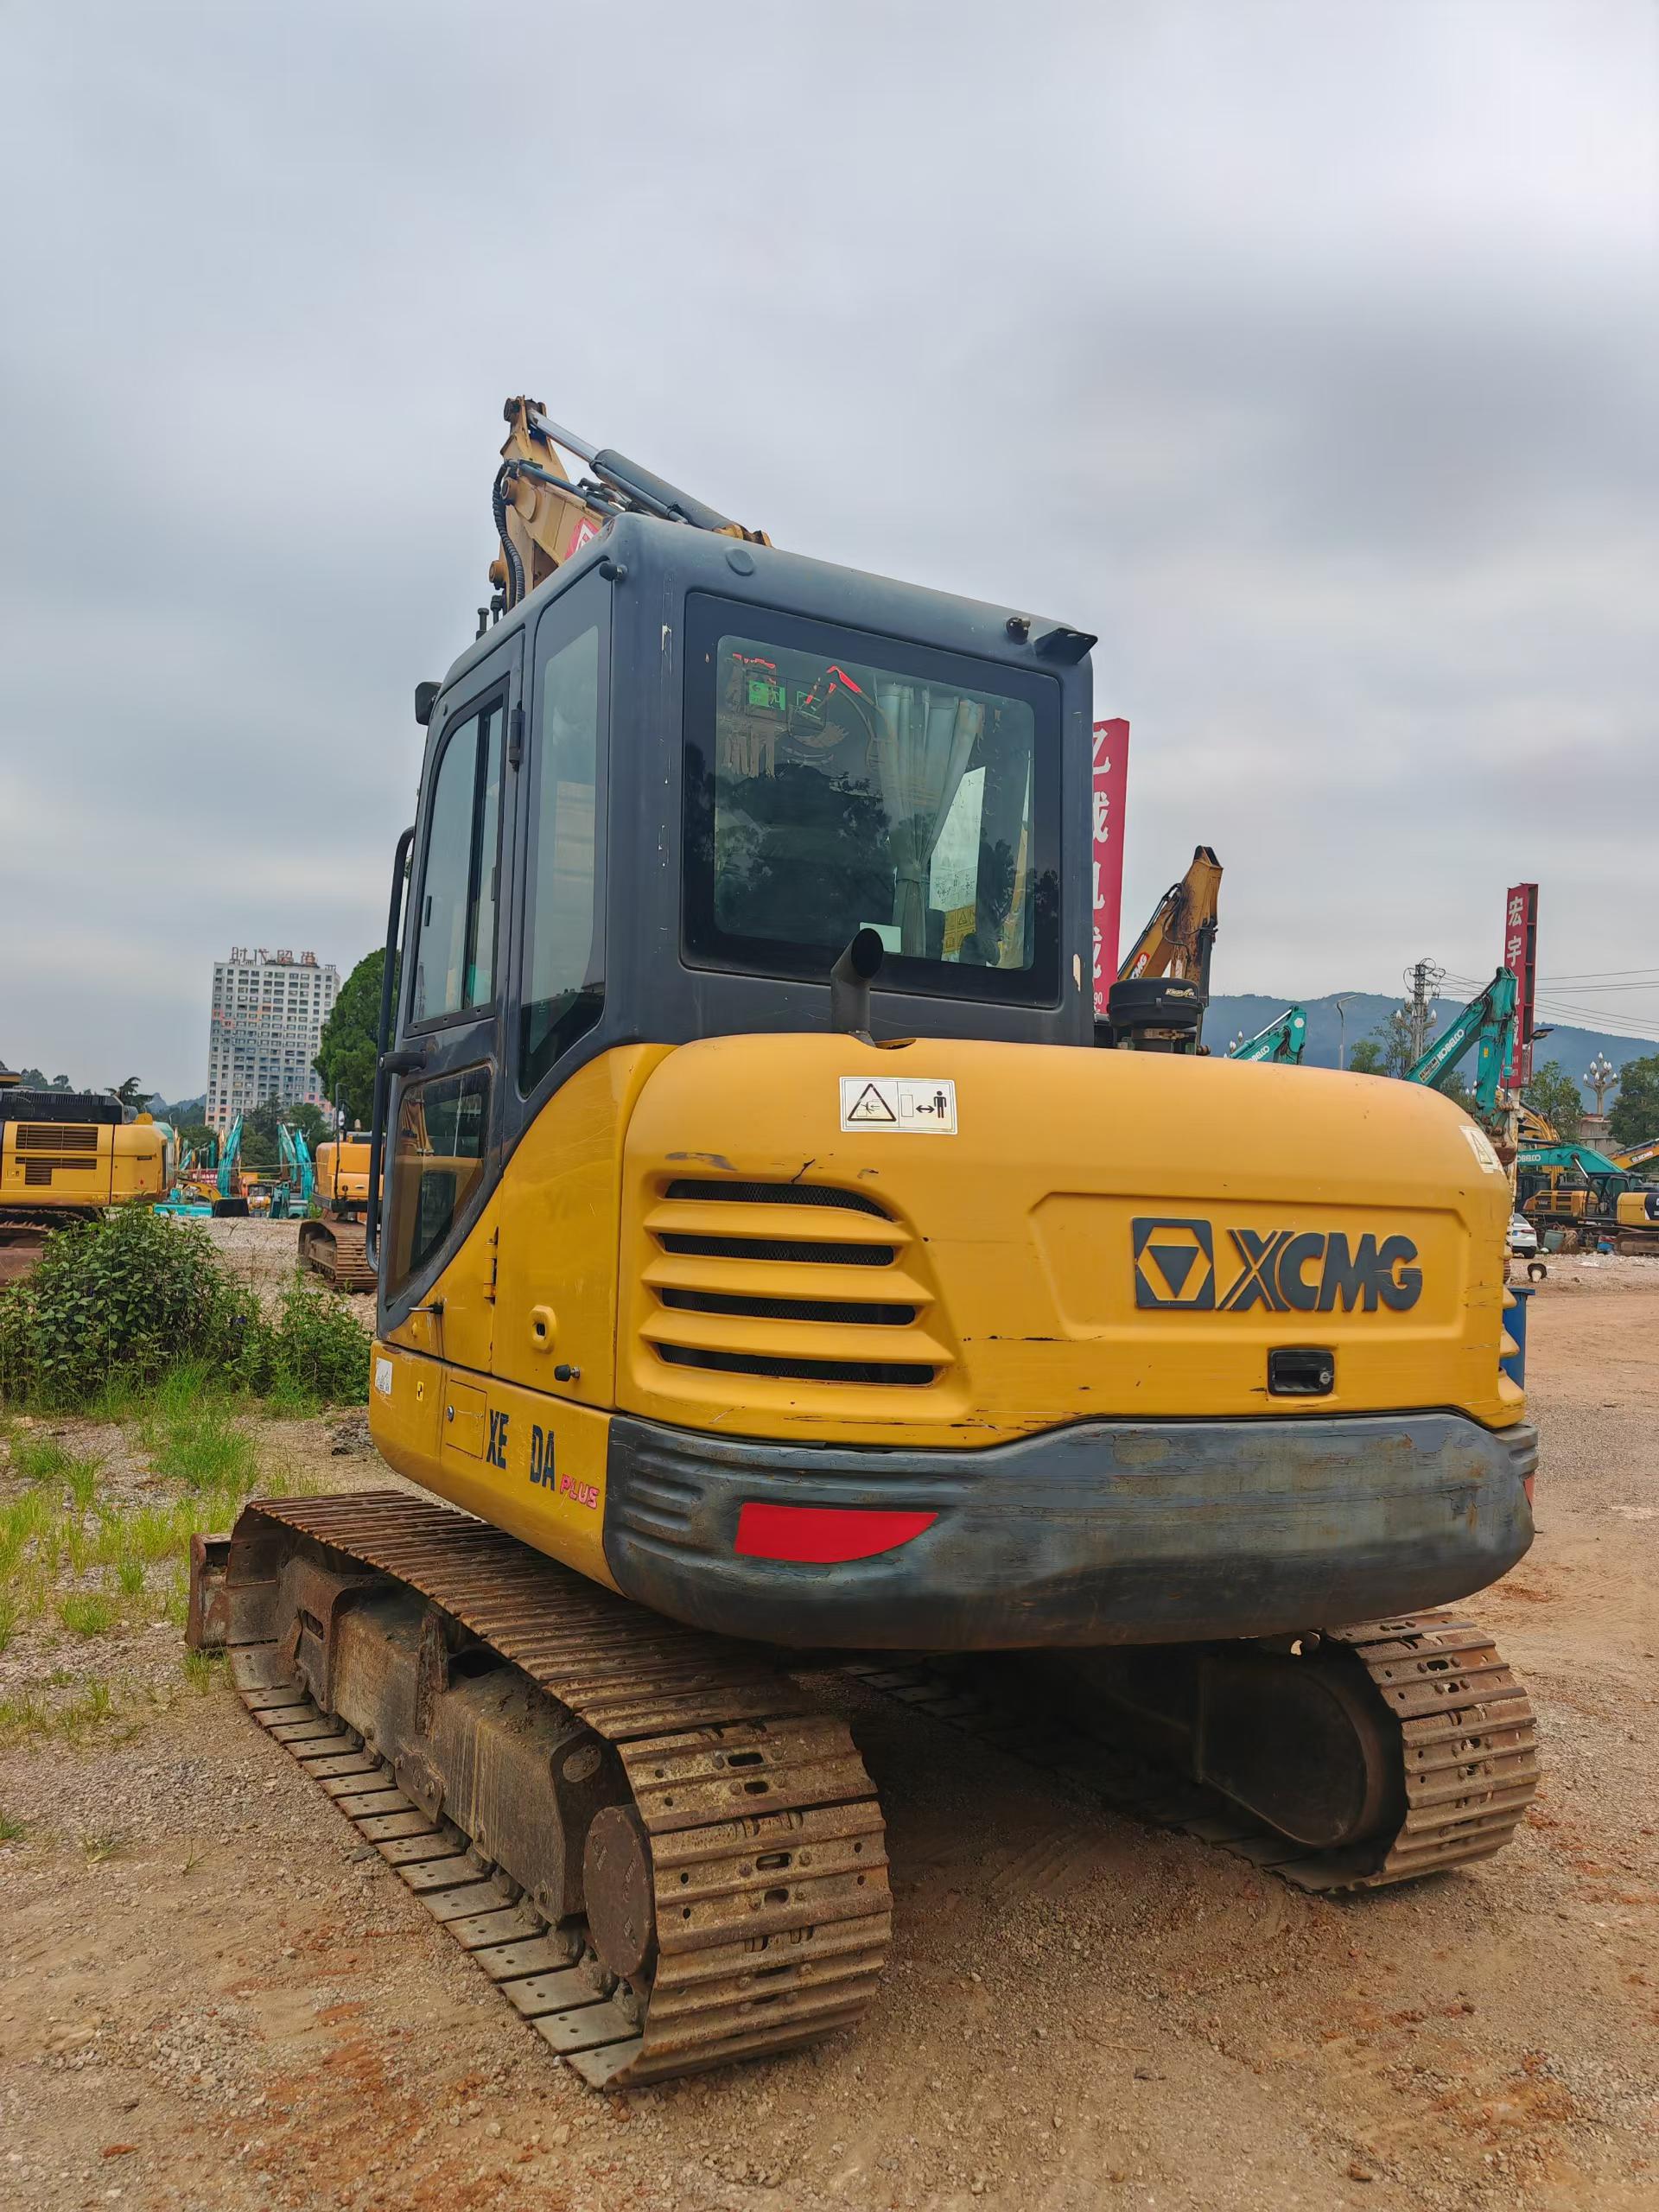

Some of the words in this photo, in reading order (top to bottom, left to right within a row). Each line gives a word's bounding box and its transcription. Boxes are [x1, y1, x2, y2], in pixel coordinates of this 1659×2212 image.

[1507, 896, 1523, 1046] 宏宇
[1437, 1029, 1464, 1061] KOBELCO
[1217, 1229, 1423, 1312] XCMG
[486, 1408, 509, 1470] XE
[529, 1424, 556, 1491] DA
[560, 1474, 600, 1510] PLUS
